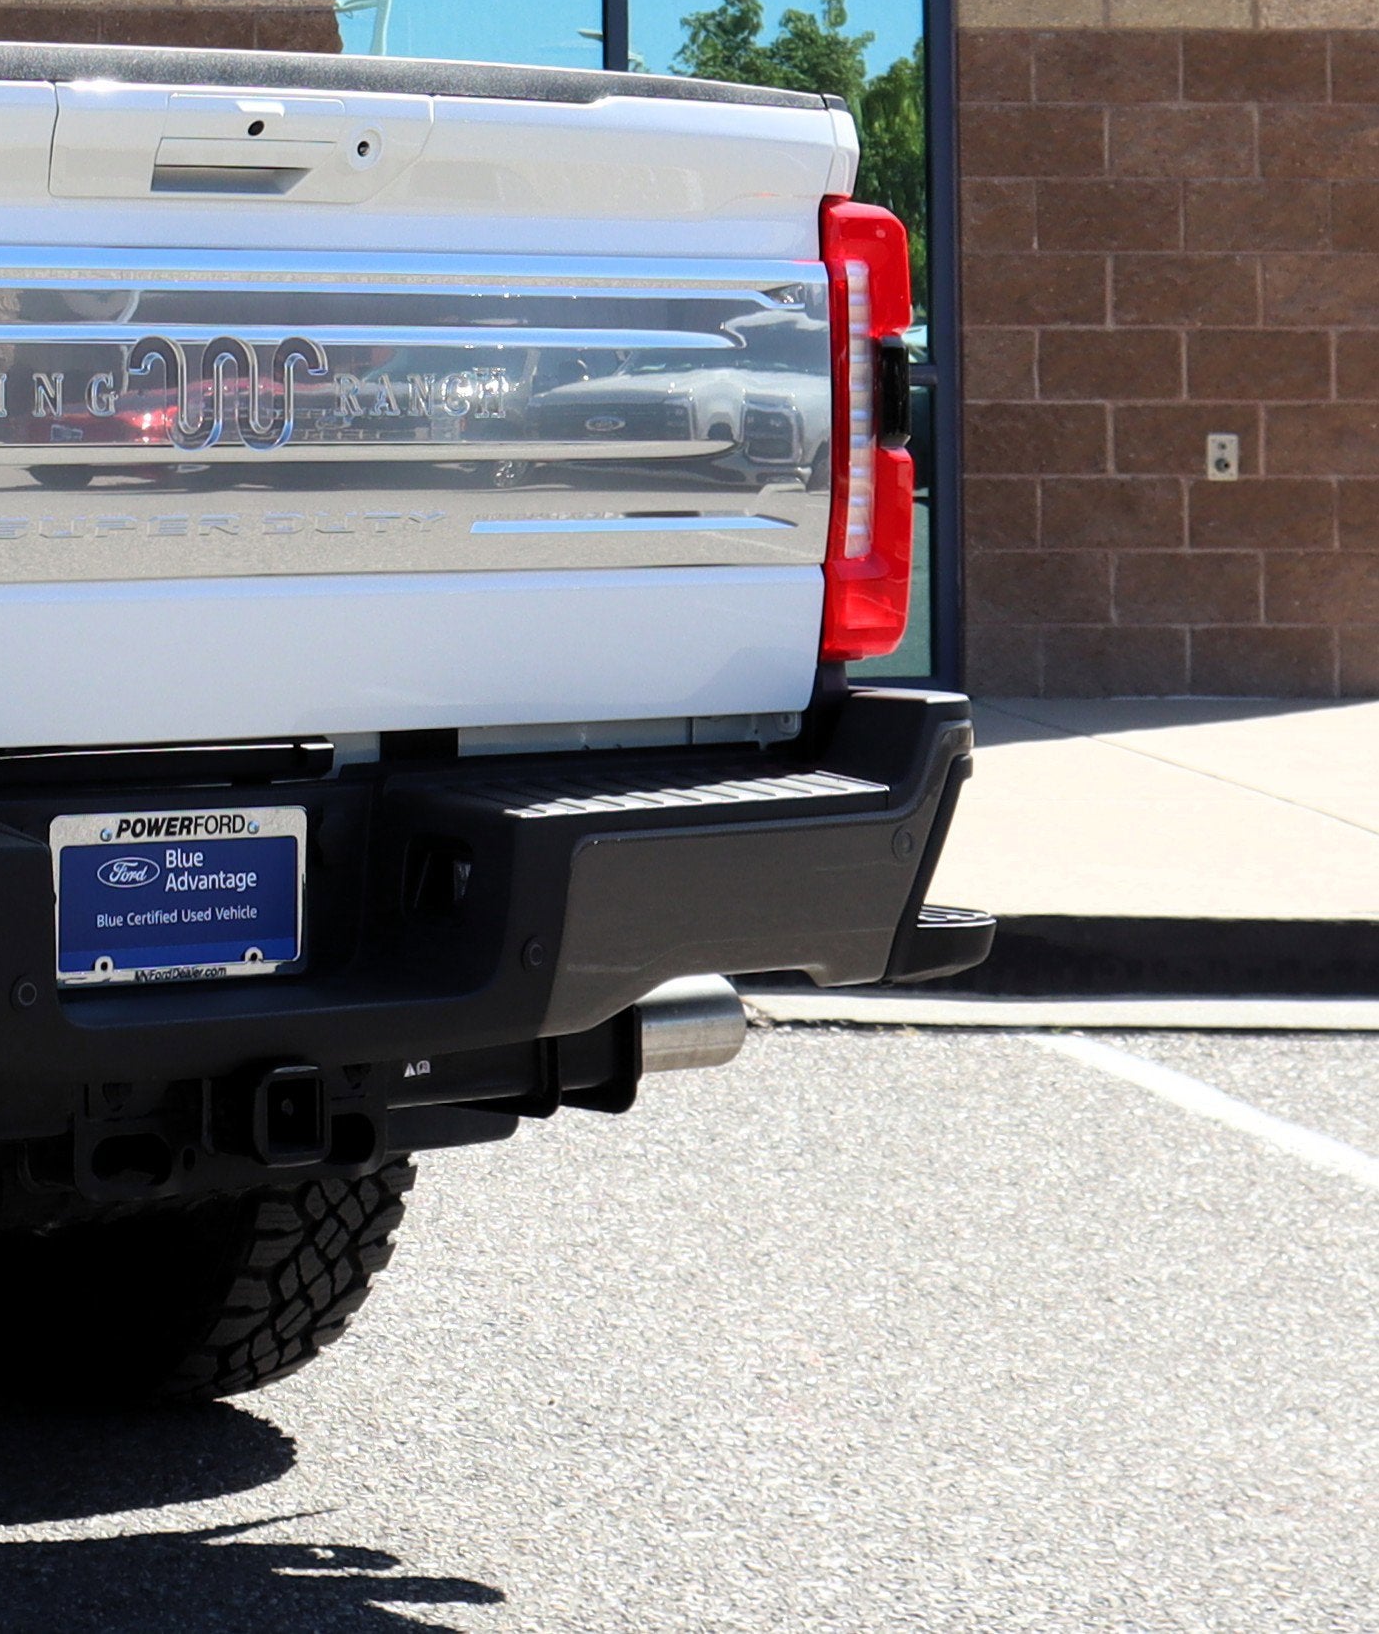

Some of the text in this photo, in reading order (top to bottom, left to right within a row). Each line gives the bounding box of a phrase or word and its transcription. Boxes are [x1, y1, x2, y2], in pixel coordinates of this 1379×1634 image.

[332, 366, 506, 419] RANCH
[262, 511, 445, 535] DUTY
[115, 814, 246, 839] POWERFORD
[165, 848, 204, 868] Blue
[109, 861, 148, 882] Ford
[165, 872, 257, 892] Advantage
[96, 904, 258, 928] Blue Certified Used Vehicle
